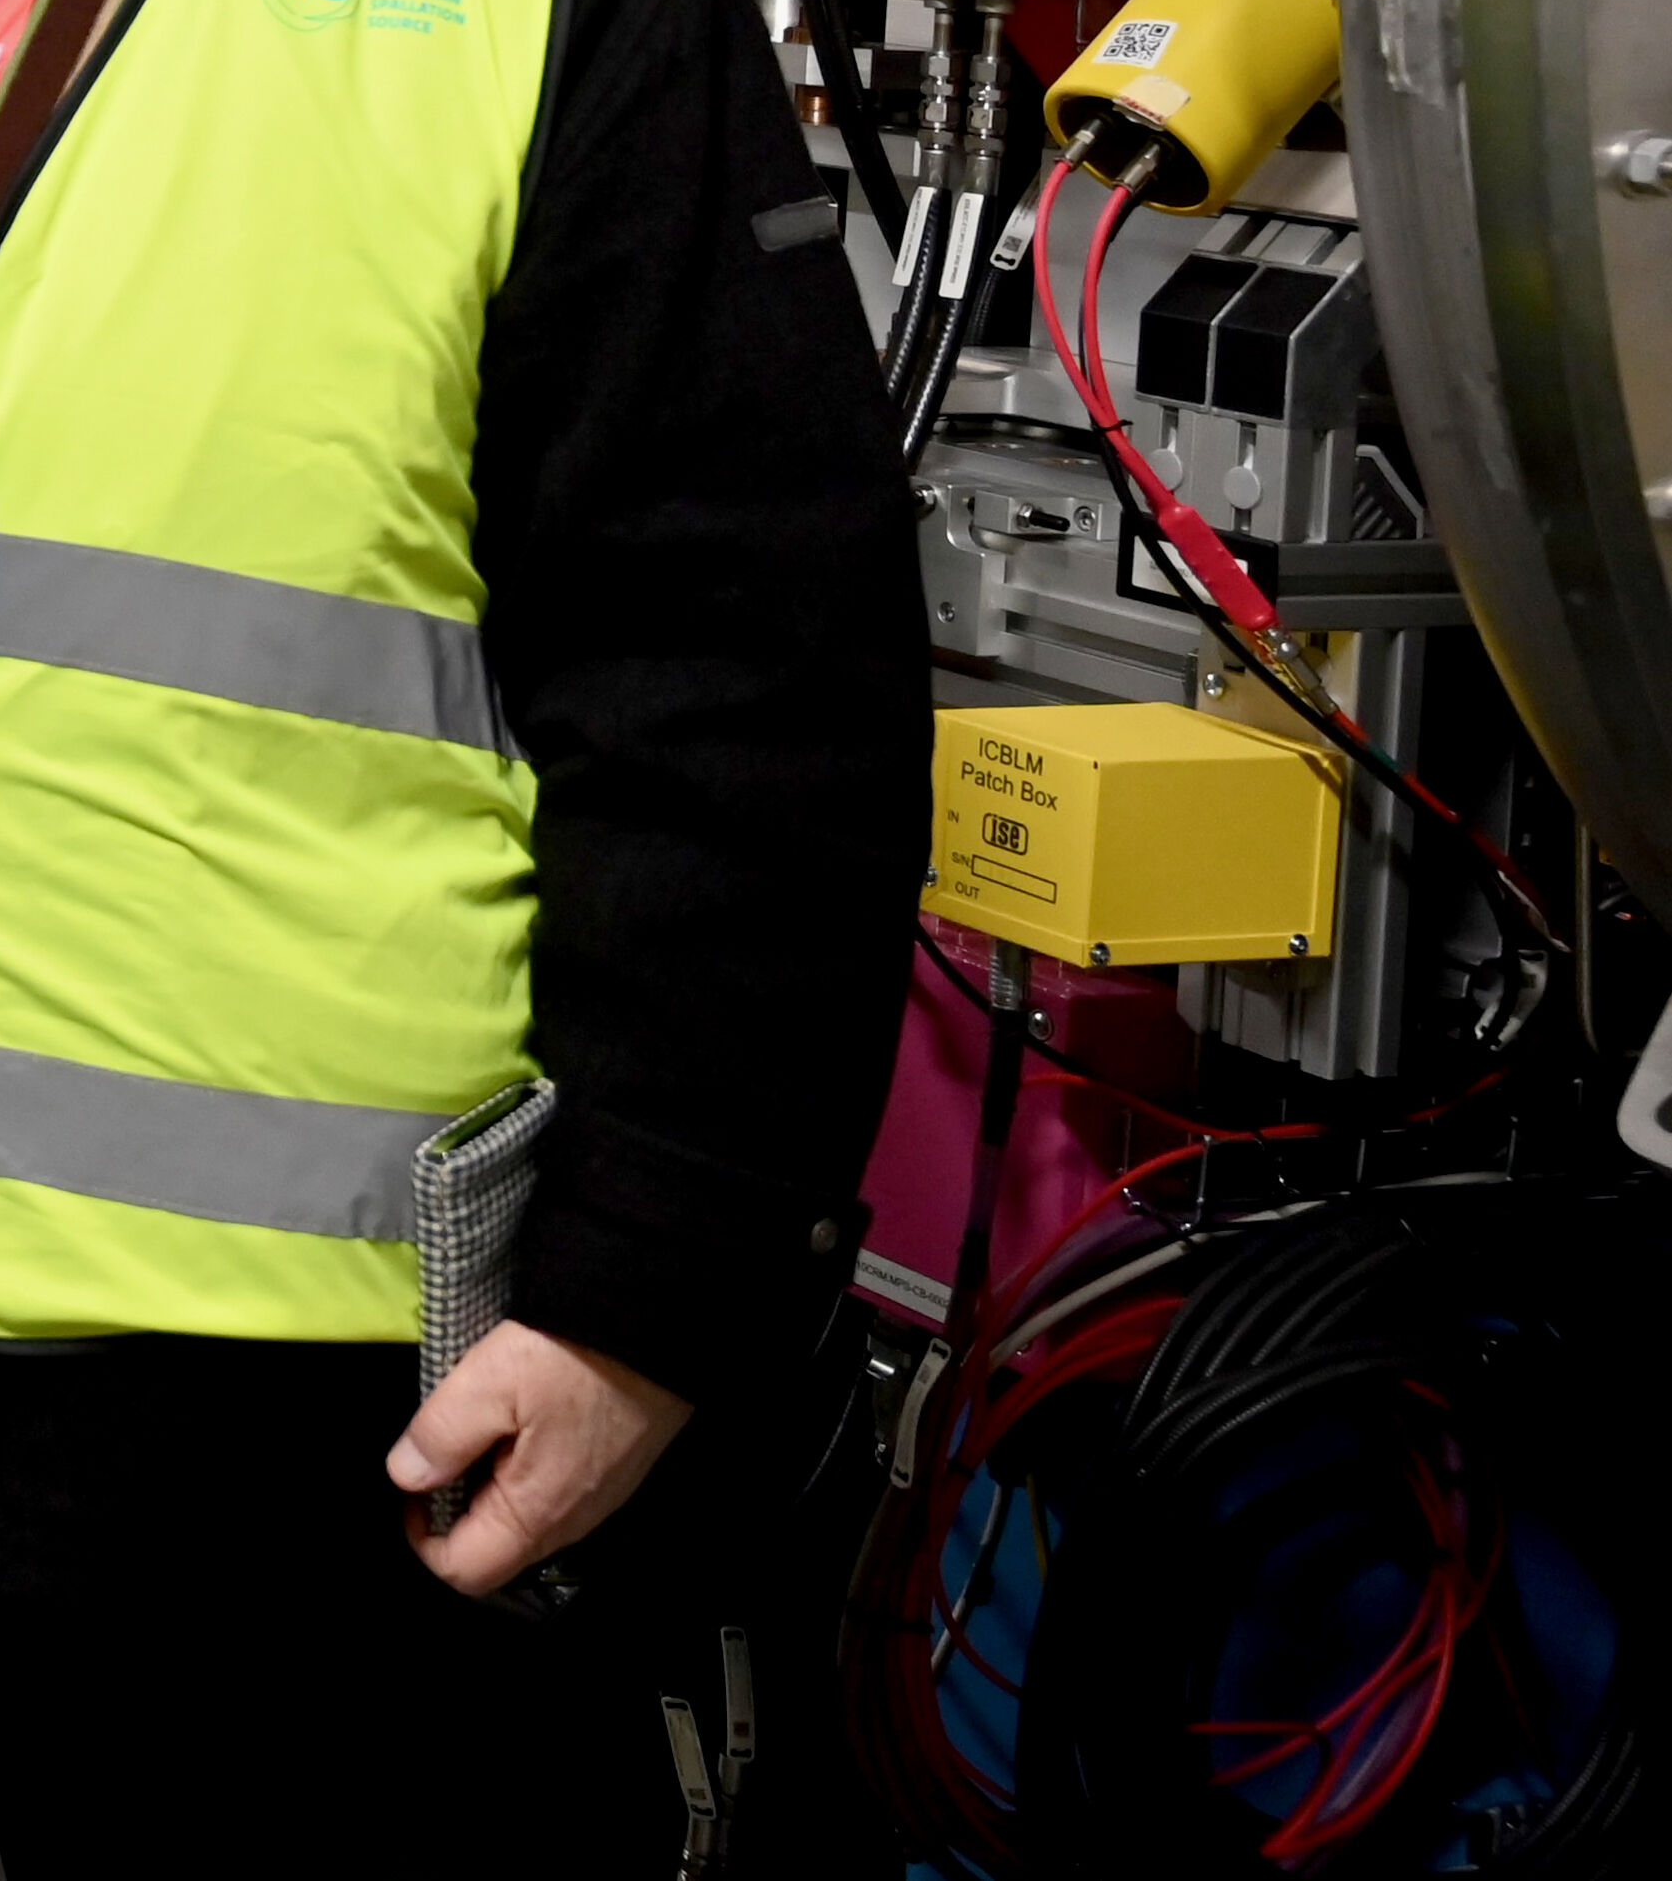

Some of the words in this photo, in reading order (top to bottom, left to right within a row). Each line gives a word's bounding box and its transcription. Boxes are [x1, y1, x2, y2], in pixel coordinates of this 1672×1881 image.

[979, 737, 1043, 776] ICBLM
[961, 761, 1014, 796] Patch
[1021, 780, 1058, 811] Box
[948, 809, 959, 823] IN
[990, 817, 1020, 849] ise
[955, 881, 980, 899] OUT
